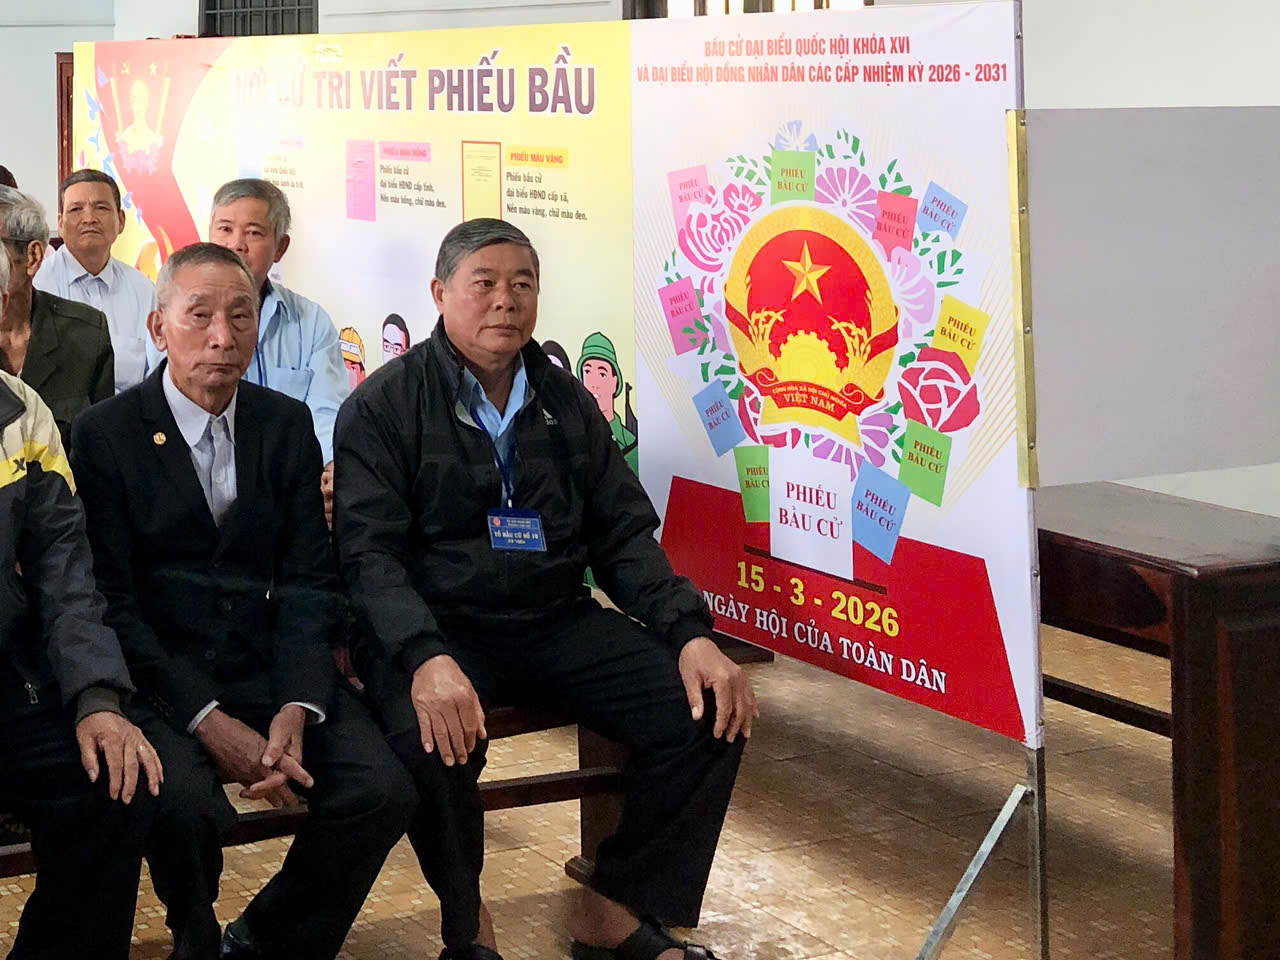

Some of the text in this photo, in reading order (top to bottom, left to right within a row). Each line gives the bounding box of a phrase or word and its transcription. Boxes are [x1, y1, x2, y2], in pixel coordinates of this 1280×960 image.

[745, 40, 763, 59] ĐẠI
[767, 32, 792, 56] BIỂU
[795, 32, 826, 57] QUỐC
[829, 34, 849, 58] HỘI
[853, 33, 886, 54] KHÓA
[890, 36, 910, 54] XVI
[313, 70, 351, 109] TRI
[360, 53, 416, 110] VIẾT
[428, 50, 515, 113] PHIẾU
[528, 46, 595, 115] BẦU
[748, 62, 778, 82] NHÂN
[782, 61, 805, 82] DÂN
[809, 61, 831, 82] CÁC
[835, 59, 859, 82] CẤP
[863, 61, 904, 86] NHIỆM
[908, 60, 924, 82] KỲ
[928, 64, 961, 82] 2026
[975, 63, 1007, 82] 2031
[784, 391, 835, 412] VIỆT NAM
[737, 561, 765, 593] 15
[789, 577, 805, 606] 3
[831, 590, 900, 637] 2026
[702, 589, 947, 694] NGÀY HỘI CỦA TOÀN DÂN
